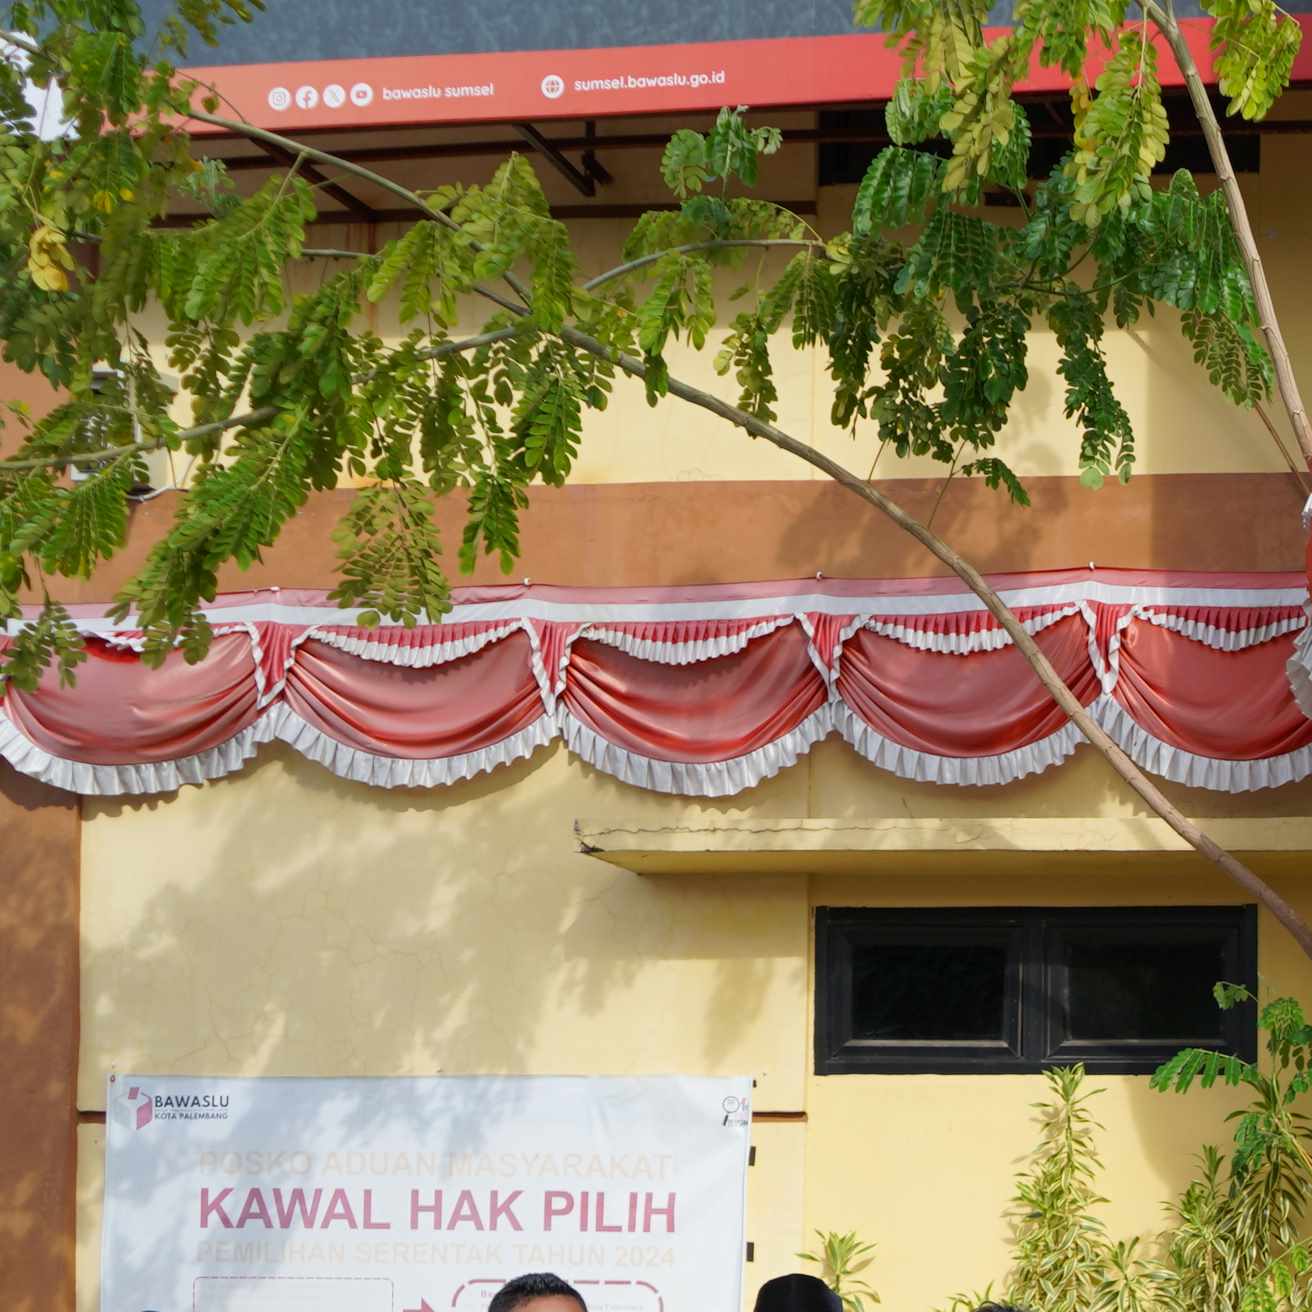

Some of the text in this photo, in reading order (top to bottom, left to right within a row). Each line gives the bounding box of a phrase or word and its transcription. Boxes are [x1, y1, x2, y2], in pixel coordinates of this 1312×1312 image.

[574, 71, 725, 91] sumsel.bawaslu.go.id
[382, 83, 495, 101] bawaslu sumsel
[154, 1095, 230, 1108] BAWASLU
[154, 1112, 229, 1121] KOTA PALEMBANG
[200, 1151, 674, 1180] POSKO ADUAN MASYARAKAT
[200, 1187, 677, 1232] KAWAL HAK PILIH
[195, 1240, 675, 1267] PEMILIHAN SERENTAK TAHUN 2024
